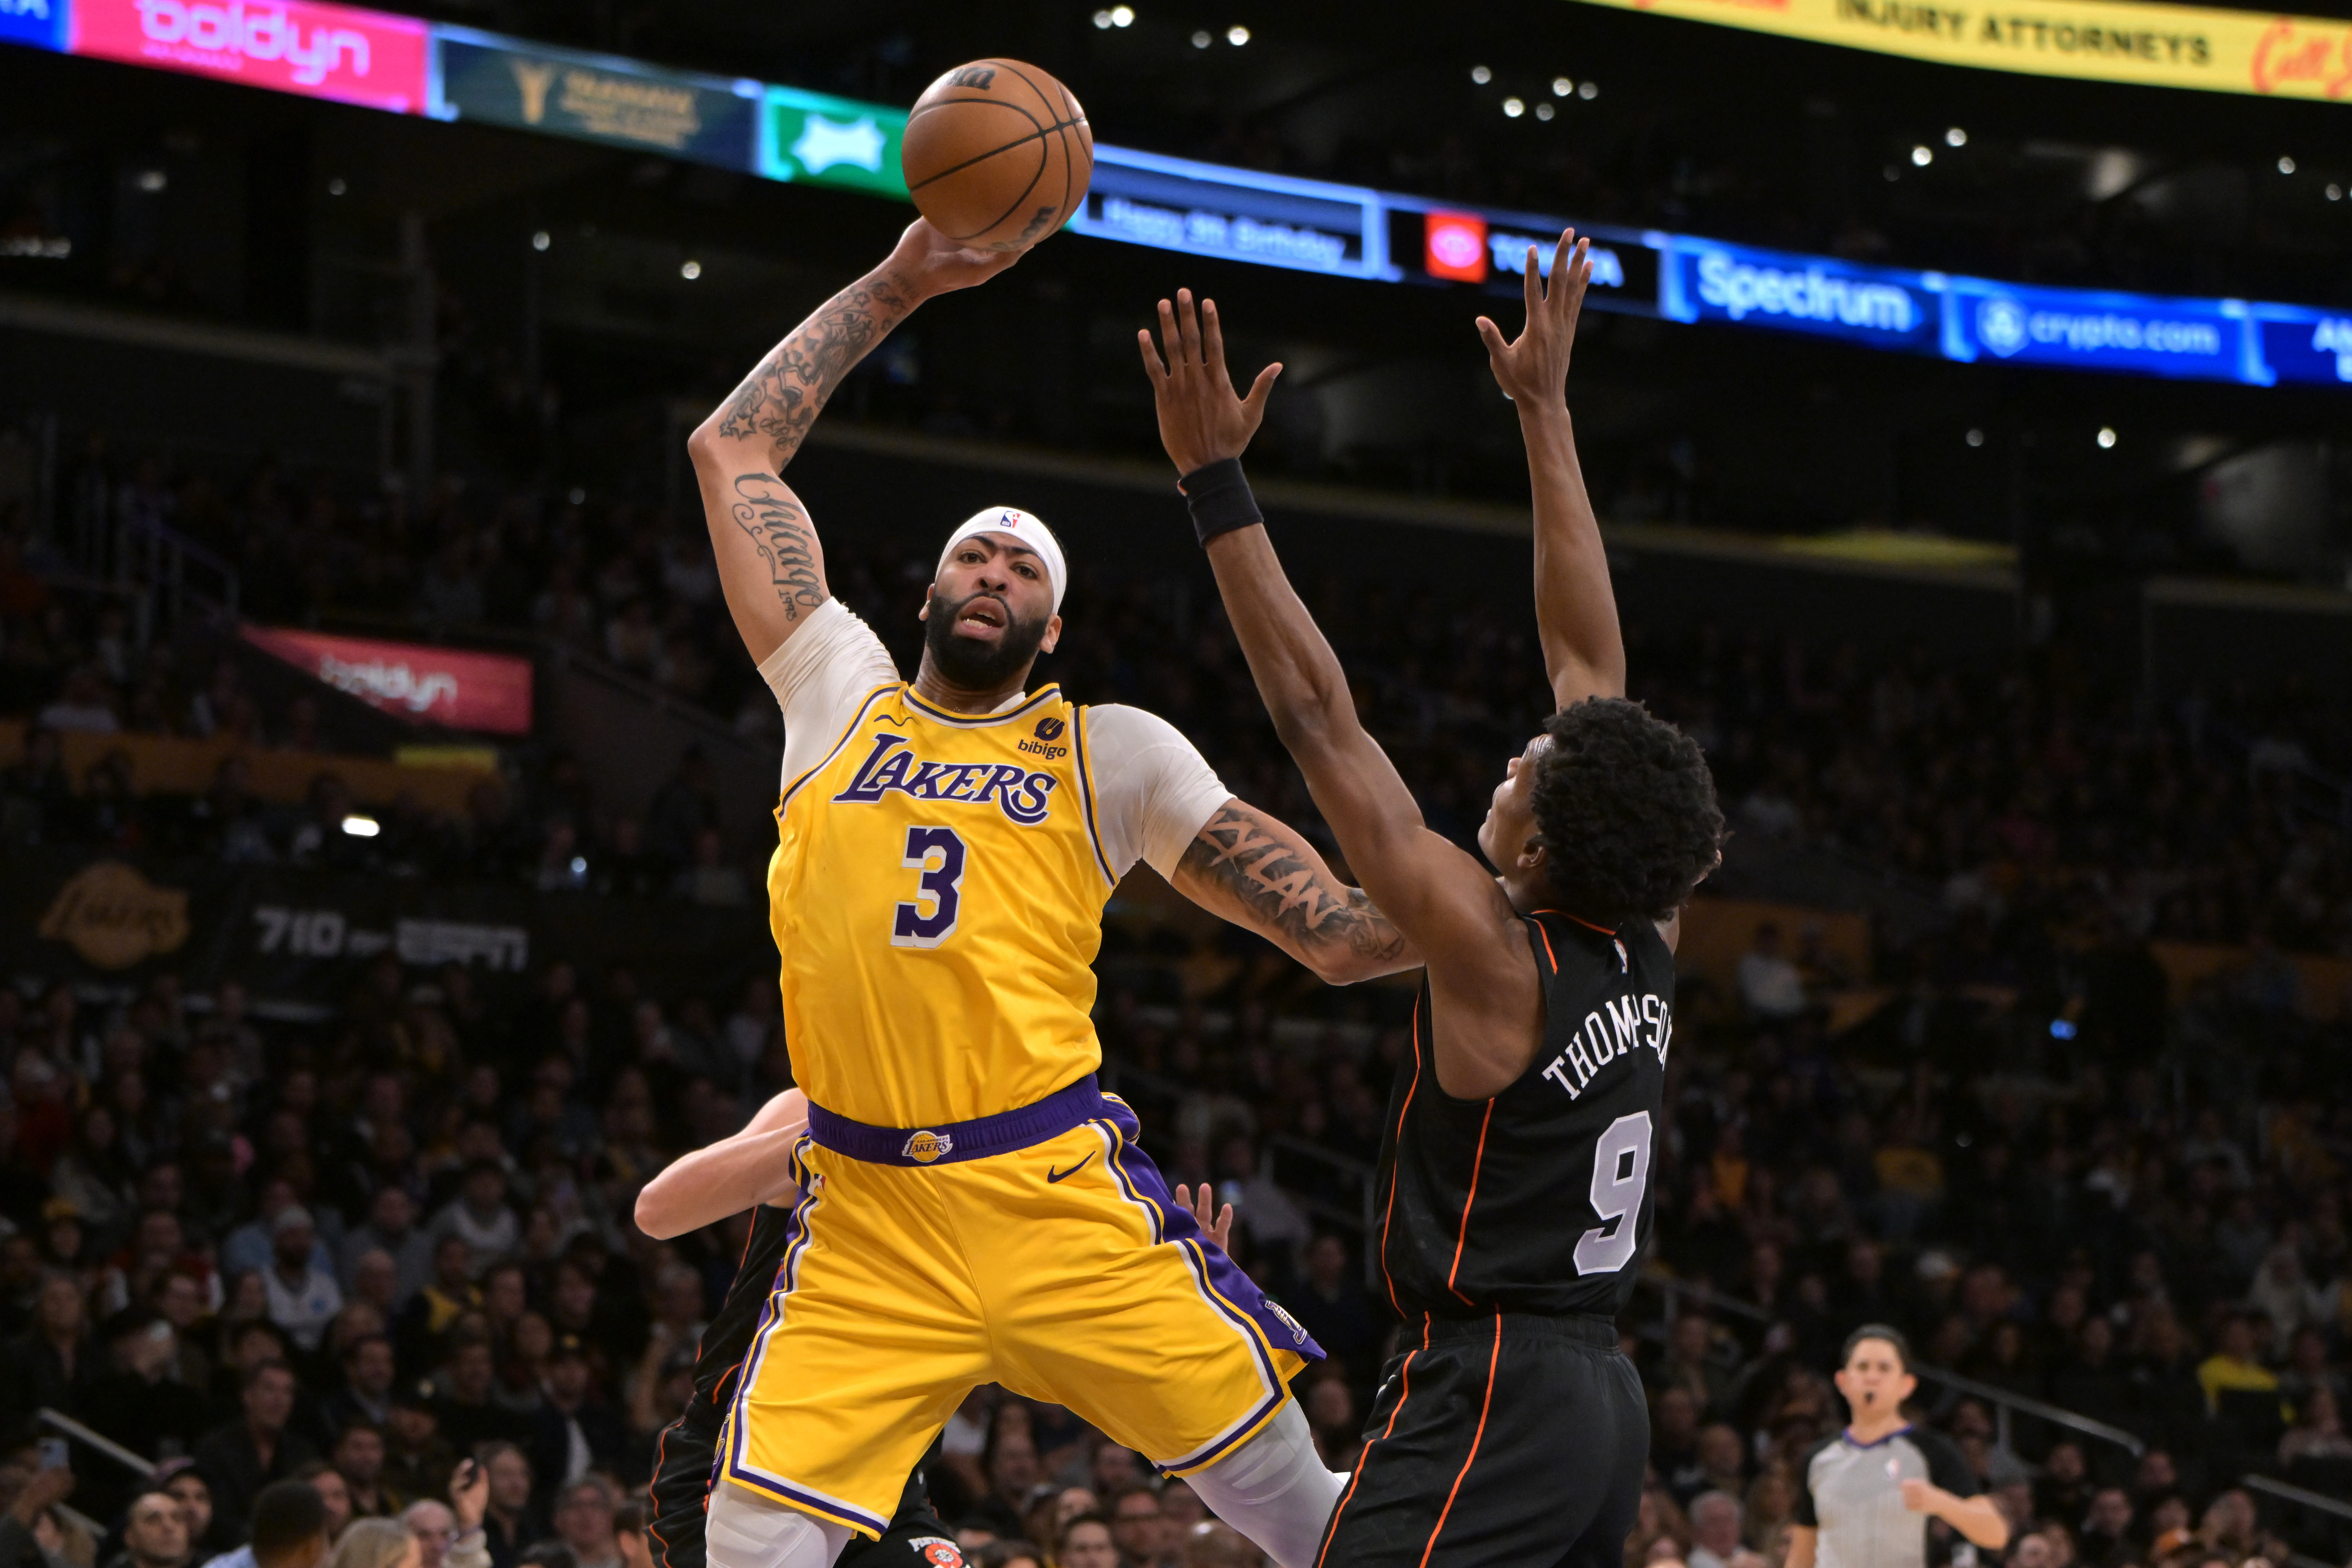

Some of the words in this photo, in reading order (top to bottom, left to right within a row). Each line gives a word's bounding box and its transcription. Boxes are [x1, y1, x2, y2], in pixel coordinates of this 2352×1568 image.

[134, 0, 370, 85] boldyn
[1836, 0, 1966, 39] INJURY
[1981, 17, 2211, 66] ATTORNEYS
[1698, 250, 1912, 332] Spectrum
[2029, 311, 2221, 355] crypto.com
[732, 473, 823, 607] Chicago
[778, 590, 797, 621] 1993
[829, 732, 1058, 826] LAKERS
[1017, 739, 1067, 760] bibigo
[890, 825, 968, 949] 3
[253, 906, 345, 956] 710
[904, 1140, 951, 1155] LAKERS
[1573, 1110, 1652, 1276] 9
